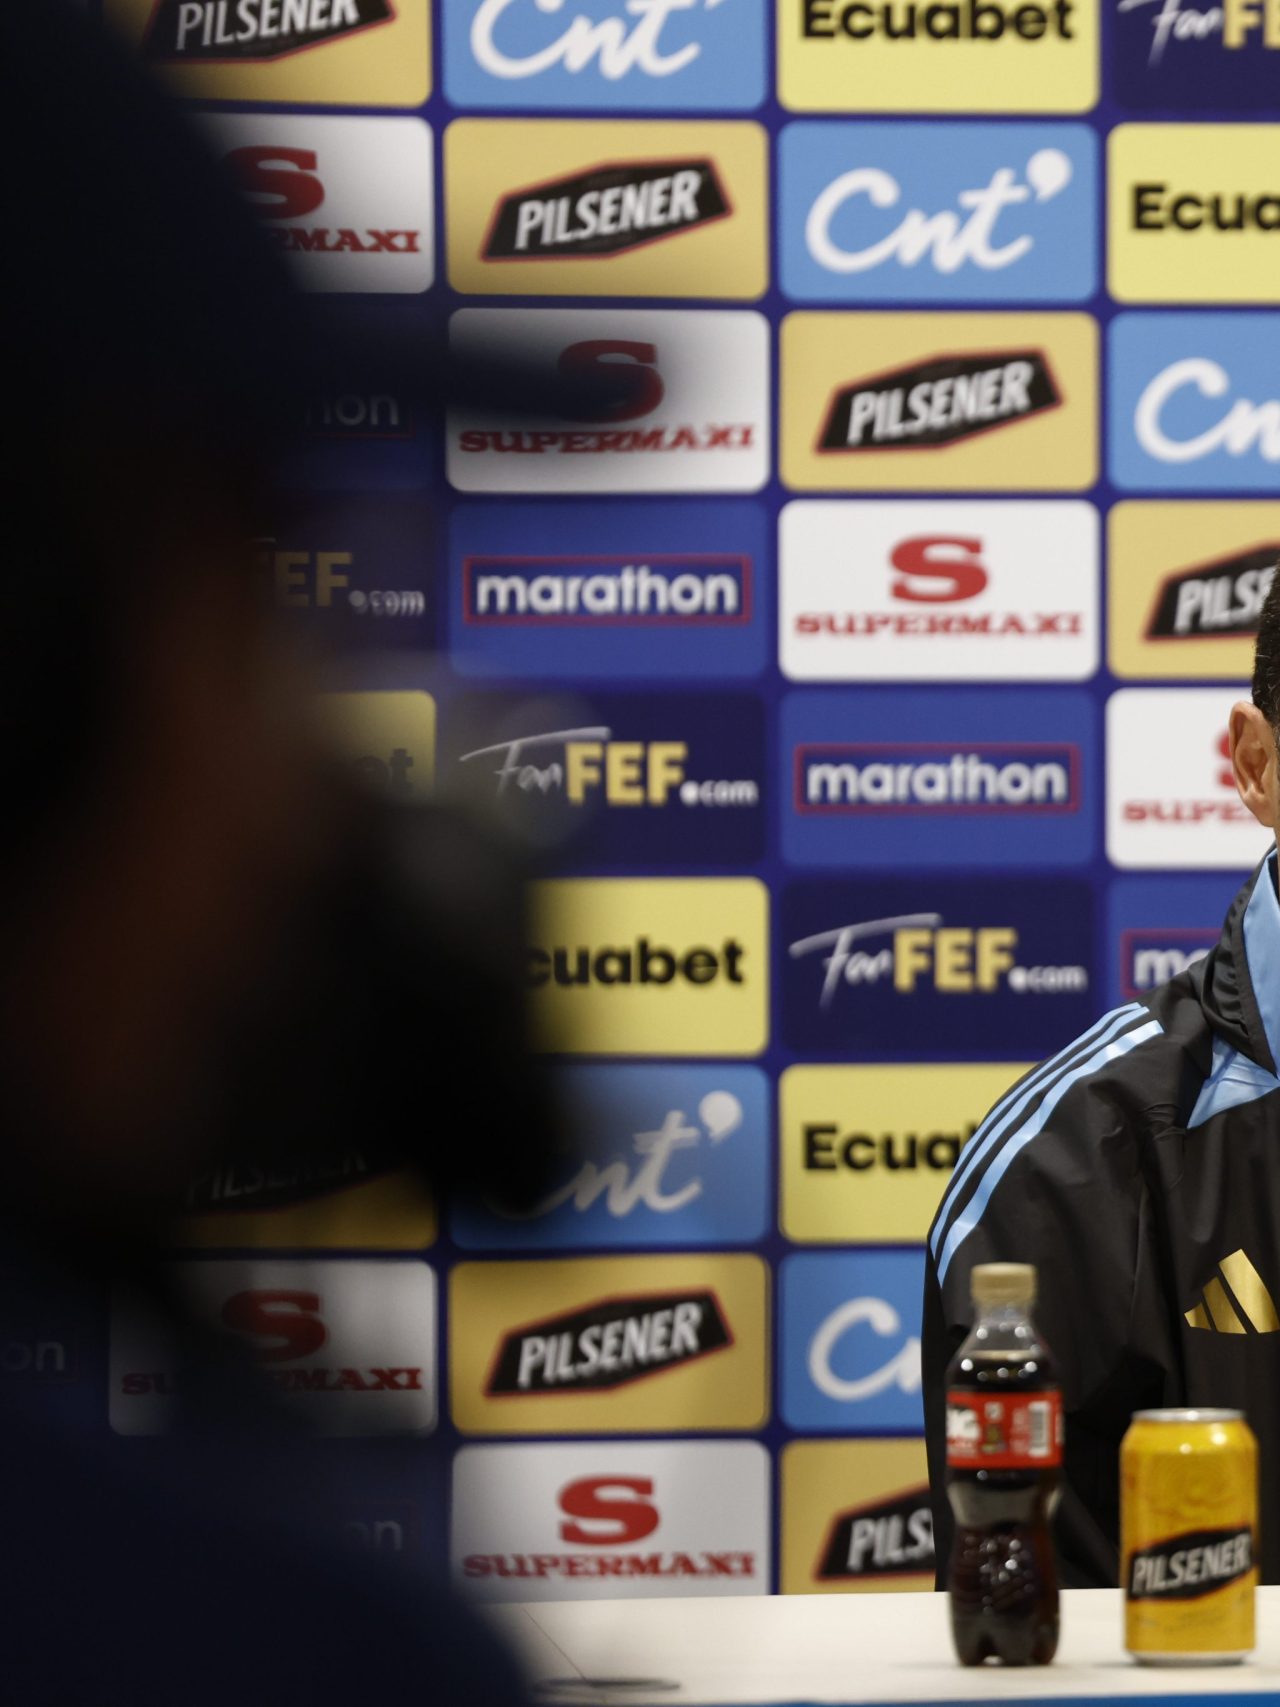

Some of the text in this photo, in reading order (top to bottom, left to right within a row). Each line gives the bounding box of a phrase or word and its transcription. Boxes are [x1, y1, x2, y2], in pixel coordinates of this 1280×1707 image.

[801, 0, 1077, 41] Ecuabet
[513, 169, 701, 251] PILSENER
[846, 361, 1034, 446] PILSENER
[458, 423, 757, 454] SUPERMAXI
[476, 564, 739, 616] marathon
[793, 611, 1082, 636] SUPERMAXI
[807, 754, 1068, 803] marathon
[528, 936, 747, 986] cuabet
[516, 1301, 703, 1390] PILSENER
[461, 1551, 756, 1580] SUPERMAXI
[1130, 1531, 1253, 1595] PILSENER
